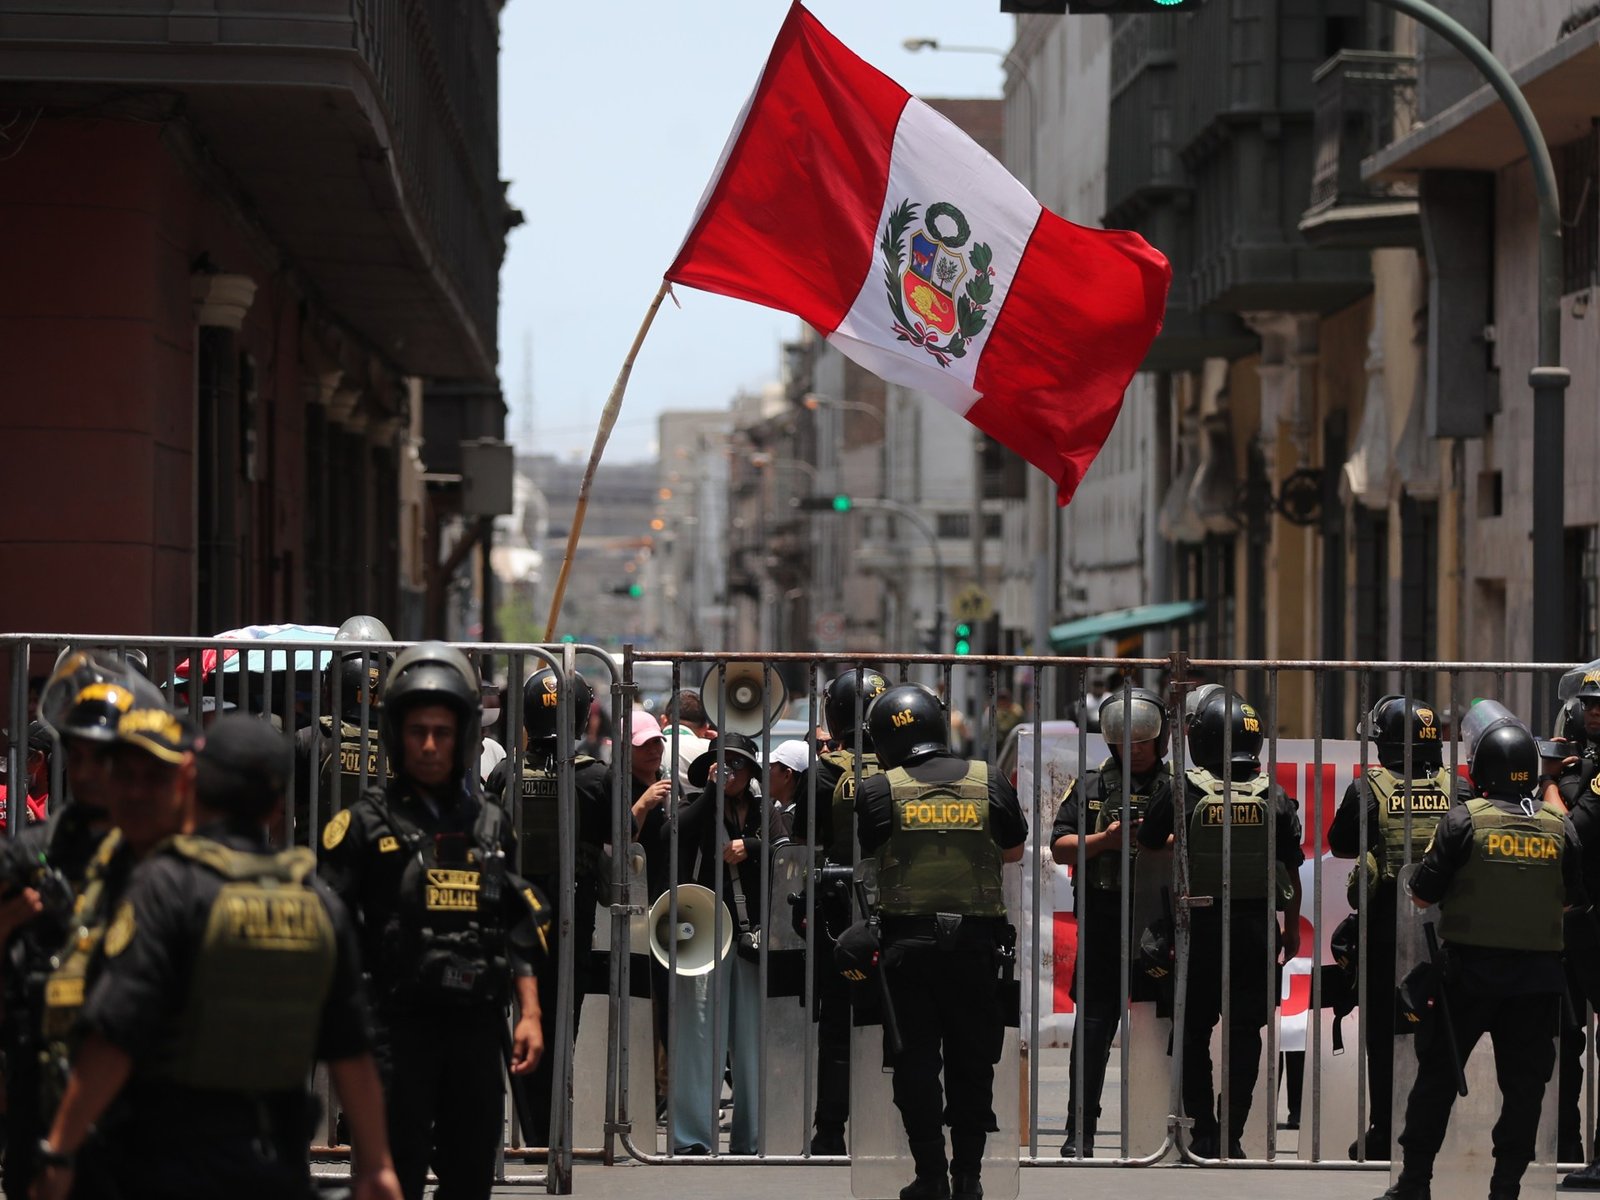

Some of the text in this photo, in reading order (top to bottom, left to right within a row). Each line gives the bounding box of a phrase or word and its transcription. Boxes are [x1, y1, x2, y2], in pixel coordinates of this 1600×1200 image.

[542, 693, 557, 707] US
[892, 709, 914, 728] USE
[1244, 717, 1260, 732] USE
[1511, 772, 1529, 781] USE
[905, 803, 978, 824] POLICIA
[1208, 805, 1259, 824] POICIA
[1488, 834, 1558, 859] POLICIA
